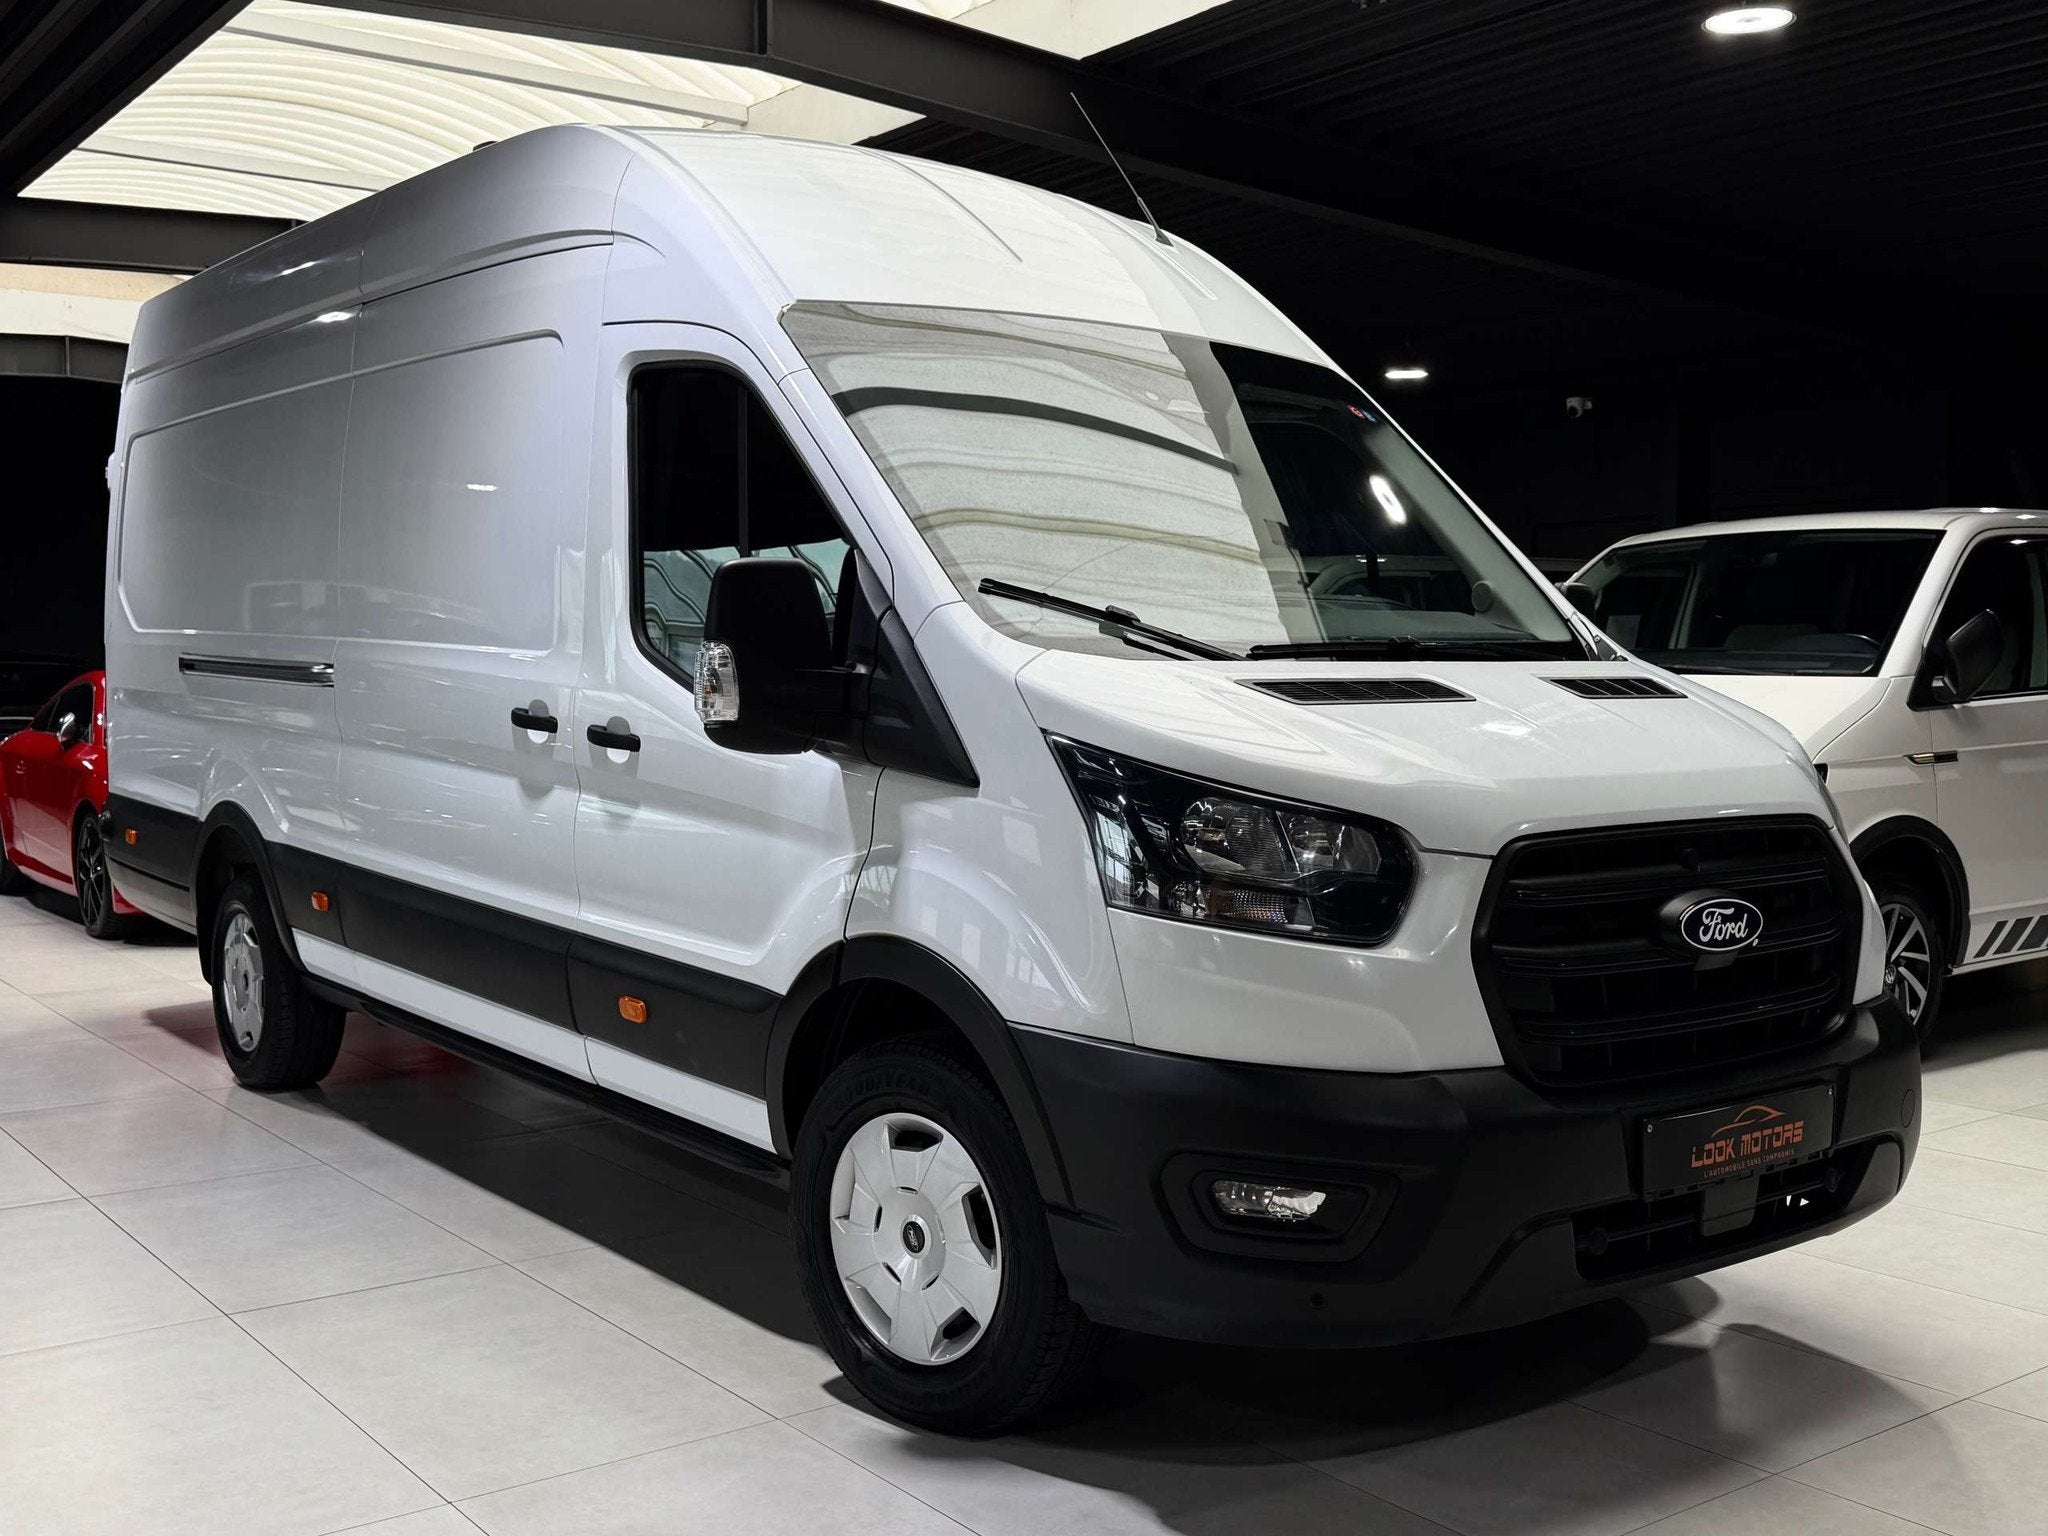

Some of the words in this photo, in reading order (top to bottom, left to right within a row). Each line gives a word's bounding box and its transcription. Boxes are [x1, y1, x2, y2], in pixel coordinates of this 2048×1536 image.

[1699, 907, 1749, 943] Ford
[1690, 1137, 1735, 1168] LOOK
[1740, 1120, 1804, 1156] MOTORS
[1703, 1160, 1746, 1178] L'AUTOMOBILE
[1746, 1157, 1762, 1168] SANS
[1763, 1148, 1795, 1163] COMPROMIS
